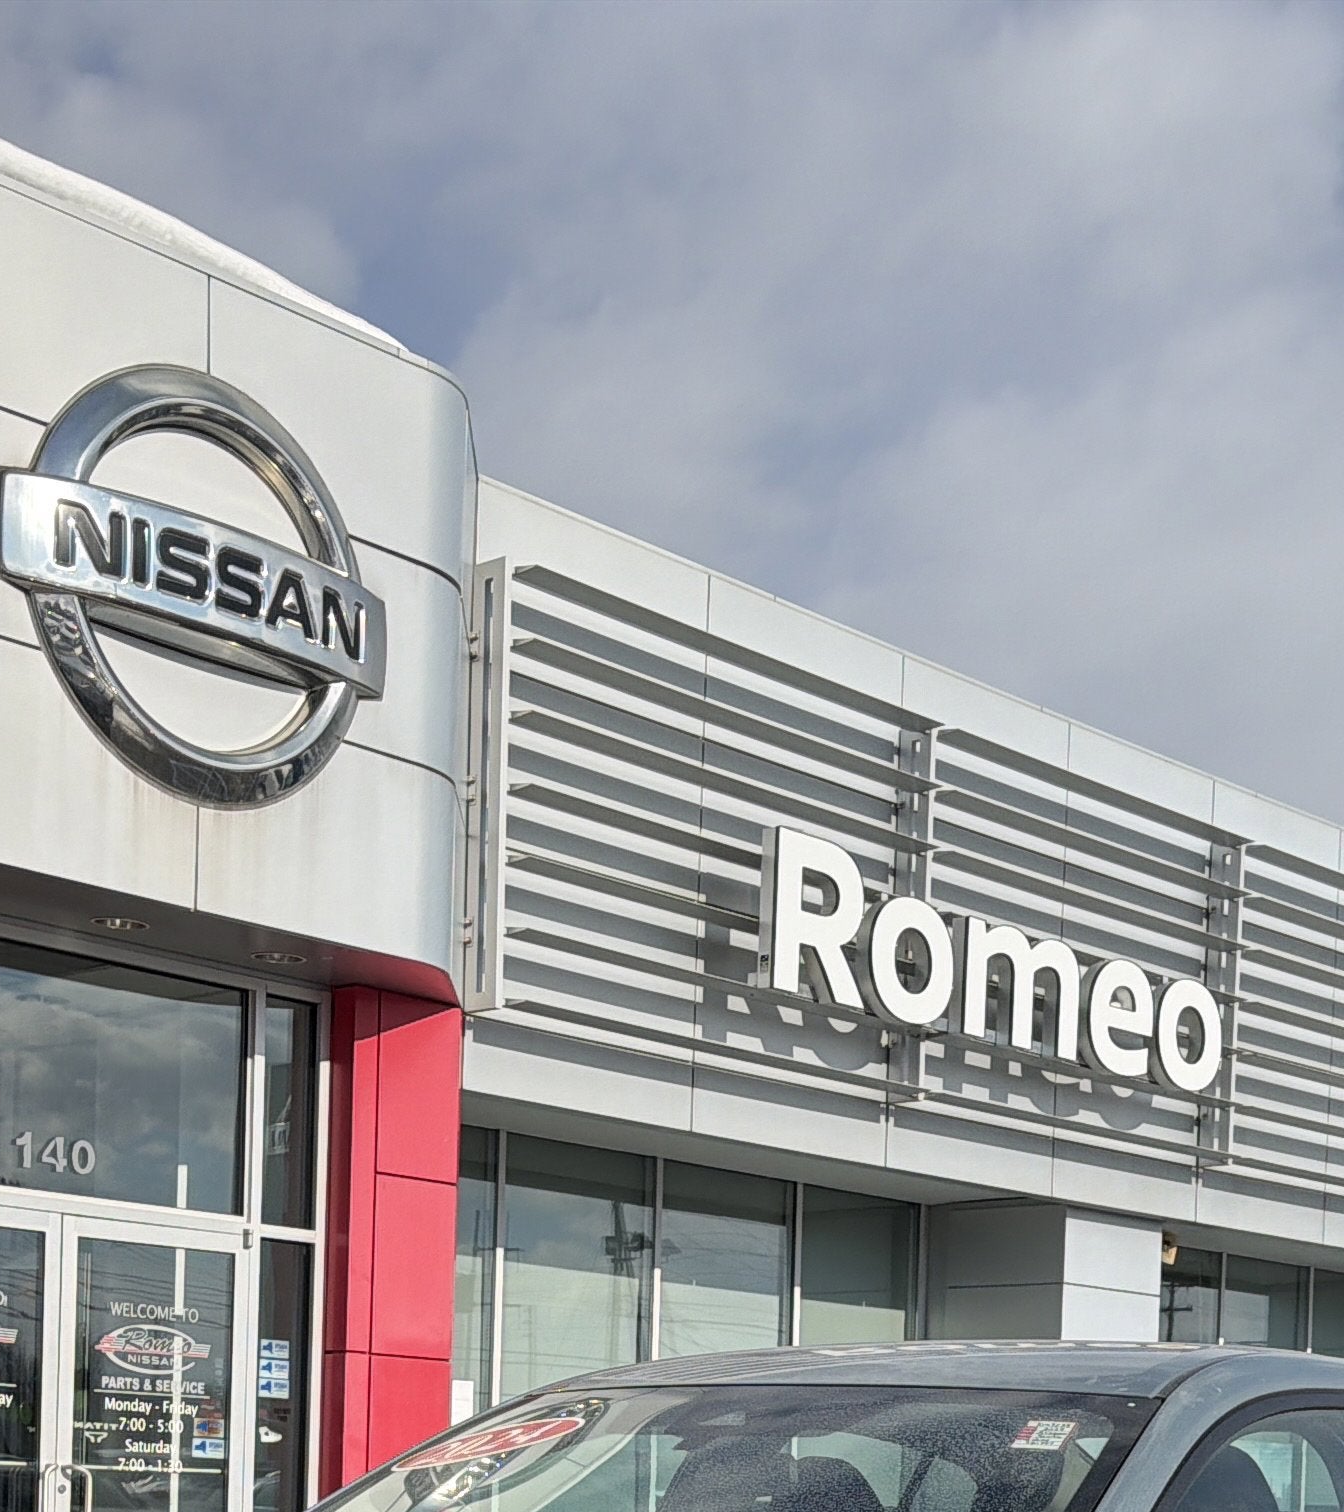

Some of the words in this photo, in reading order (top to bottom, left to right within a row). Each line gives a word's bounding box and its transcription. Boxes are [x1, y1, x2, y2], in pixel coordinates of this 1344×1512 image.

[53, 497, 367, 664] NISSAN
[762, 825, 1223, 1092] Romeo
[14, 1131, 96, 1175] 140
[110, 1301, 177, 1321] WELCOME
[179, 1308, 199, 1323] TO
[117, 1327, 192, 1354] Romo
[101, 1376, 140, 1390] PARTS
[143, 1379, 152, 1391] &
[104, 1397, 152, 1415] Monday
[162, 1400, 198, 1418] Frday
[118, 1417, 146, 1432] 7:00
[157, 1419, 184, 1434] 5:00
[125, 1438, 177, 1454] Saturday
[118, 1457, 145, 1472] 7:00
[157, 1459, 183, 1474] 1:30
